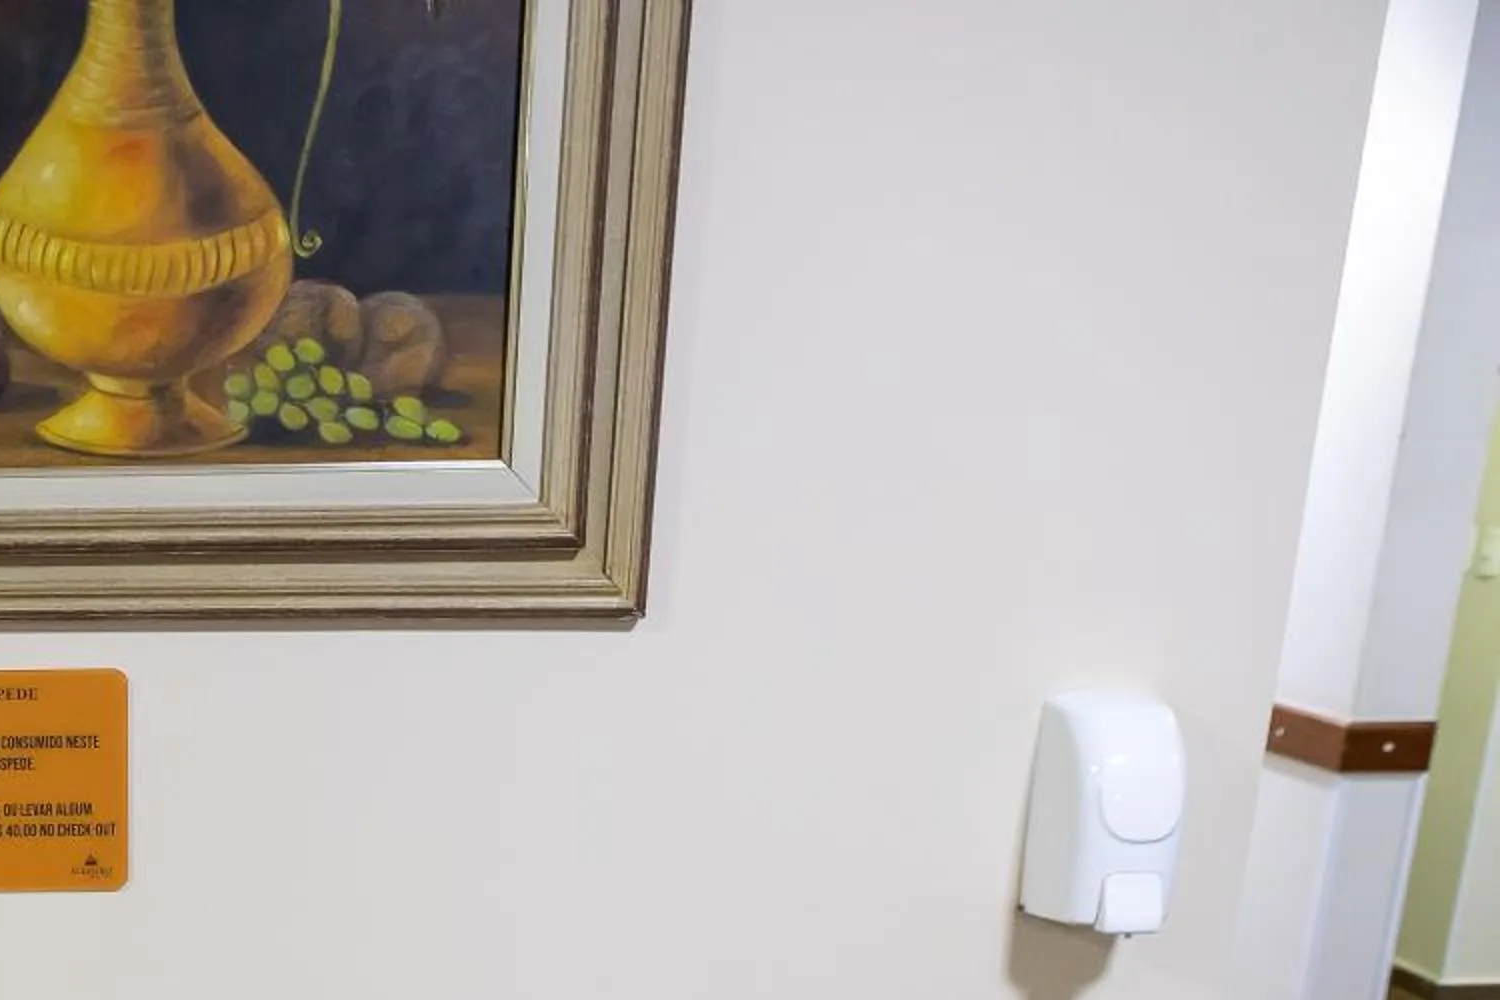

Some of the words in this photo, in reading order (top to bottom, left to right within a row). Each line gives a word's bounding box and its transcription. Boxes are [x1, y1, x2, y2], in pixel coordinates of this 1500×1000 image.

[1, 734, 63, 750] CONSUMIDO
[66, 734, 100, 749] NESTE
[3, 803, 17, 816] OU
[20, 802, 53, 816] LEVAR
[55, 801, 93, 816] ALGUM
[40, 823, 55, 837] NO
